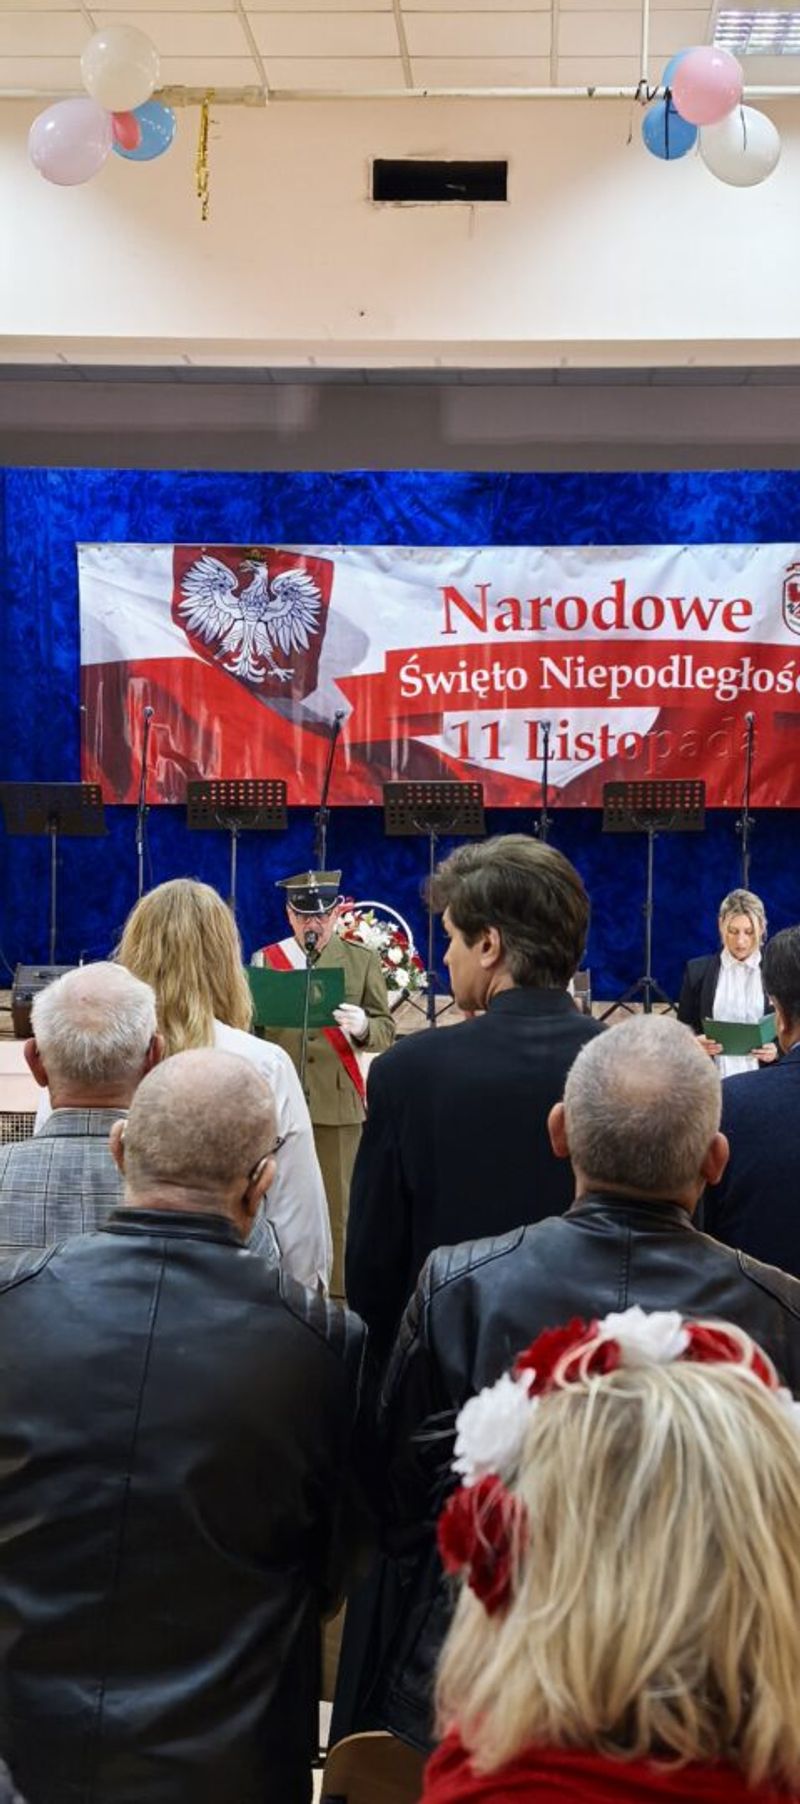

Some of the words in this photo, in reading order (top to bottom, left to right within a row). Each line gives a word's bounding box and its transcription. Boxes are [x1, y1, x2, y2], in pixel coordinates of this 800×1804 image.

[440, 578, 753, 634] Narodowe
[399, 653, 528, 698] Święto
[539, 654, 800, 701] Niepodległoś
[450, 719, 505, 760] 11
